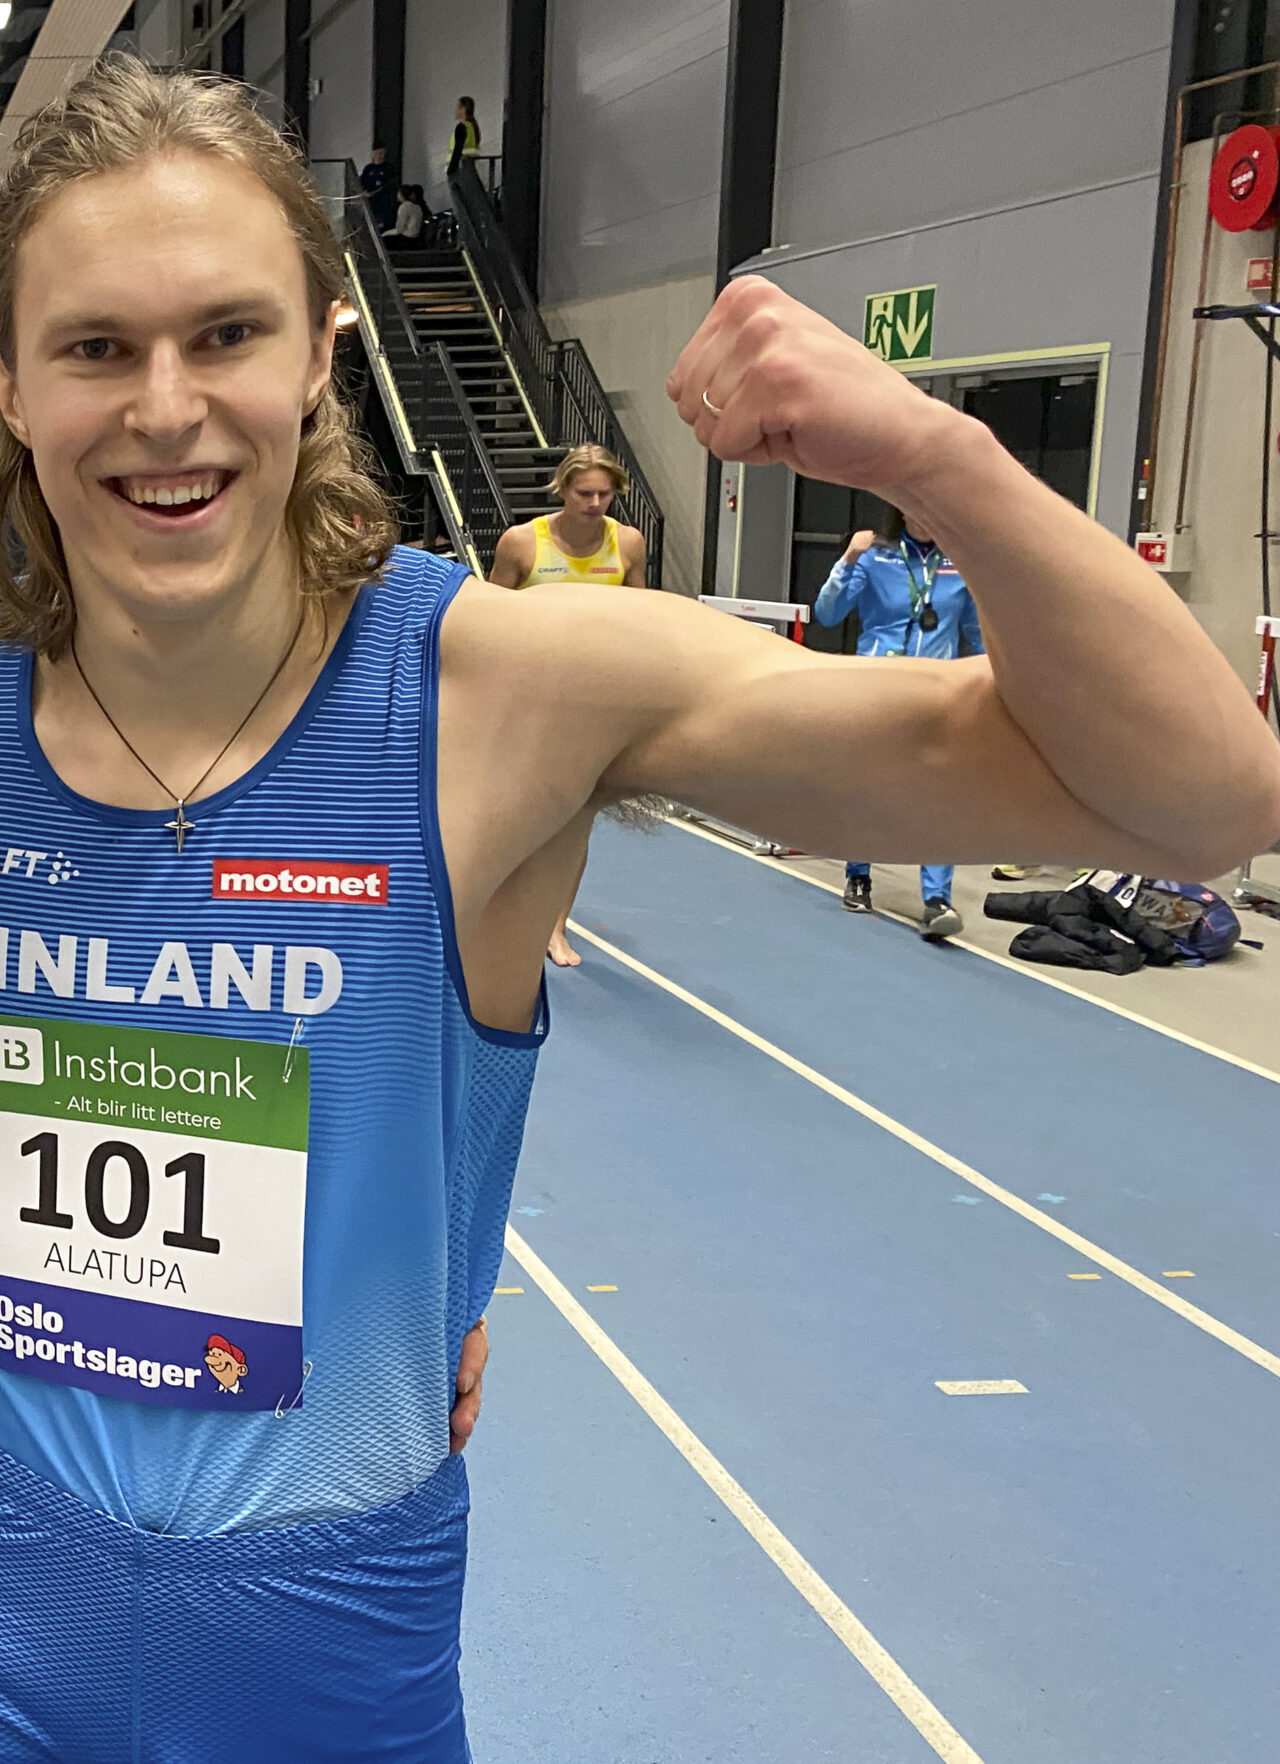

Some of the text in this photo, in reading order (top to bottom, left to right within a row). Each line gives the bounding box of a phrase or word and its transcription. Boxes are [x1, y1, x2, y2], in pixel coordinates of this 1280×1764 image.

[220, 866, 381, 898] motonet
[54, 1041, 257, 1101] Instabank
[67, 1095, 92, 1114] Alt
[97, 1098, 126, 1118] blir
[131, 1103, 156, 1122] litt
[161, 1106, 222, 1130] lettere
[19, 1131, 220, 1255] 101
[43, 1242, 188, 1294] ALATUPA
